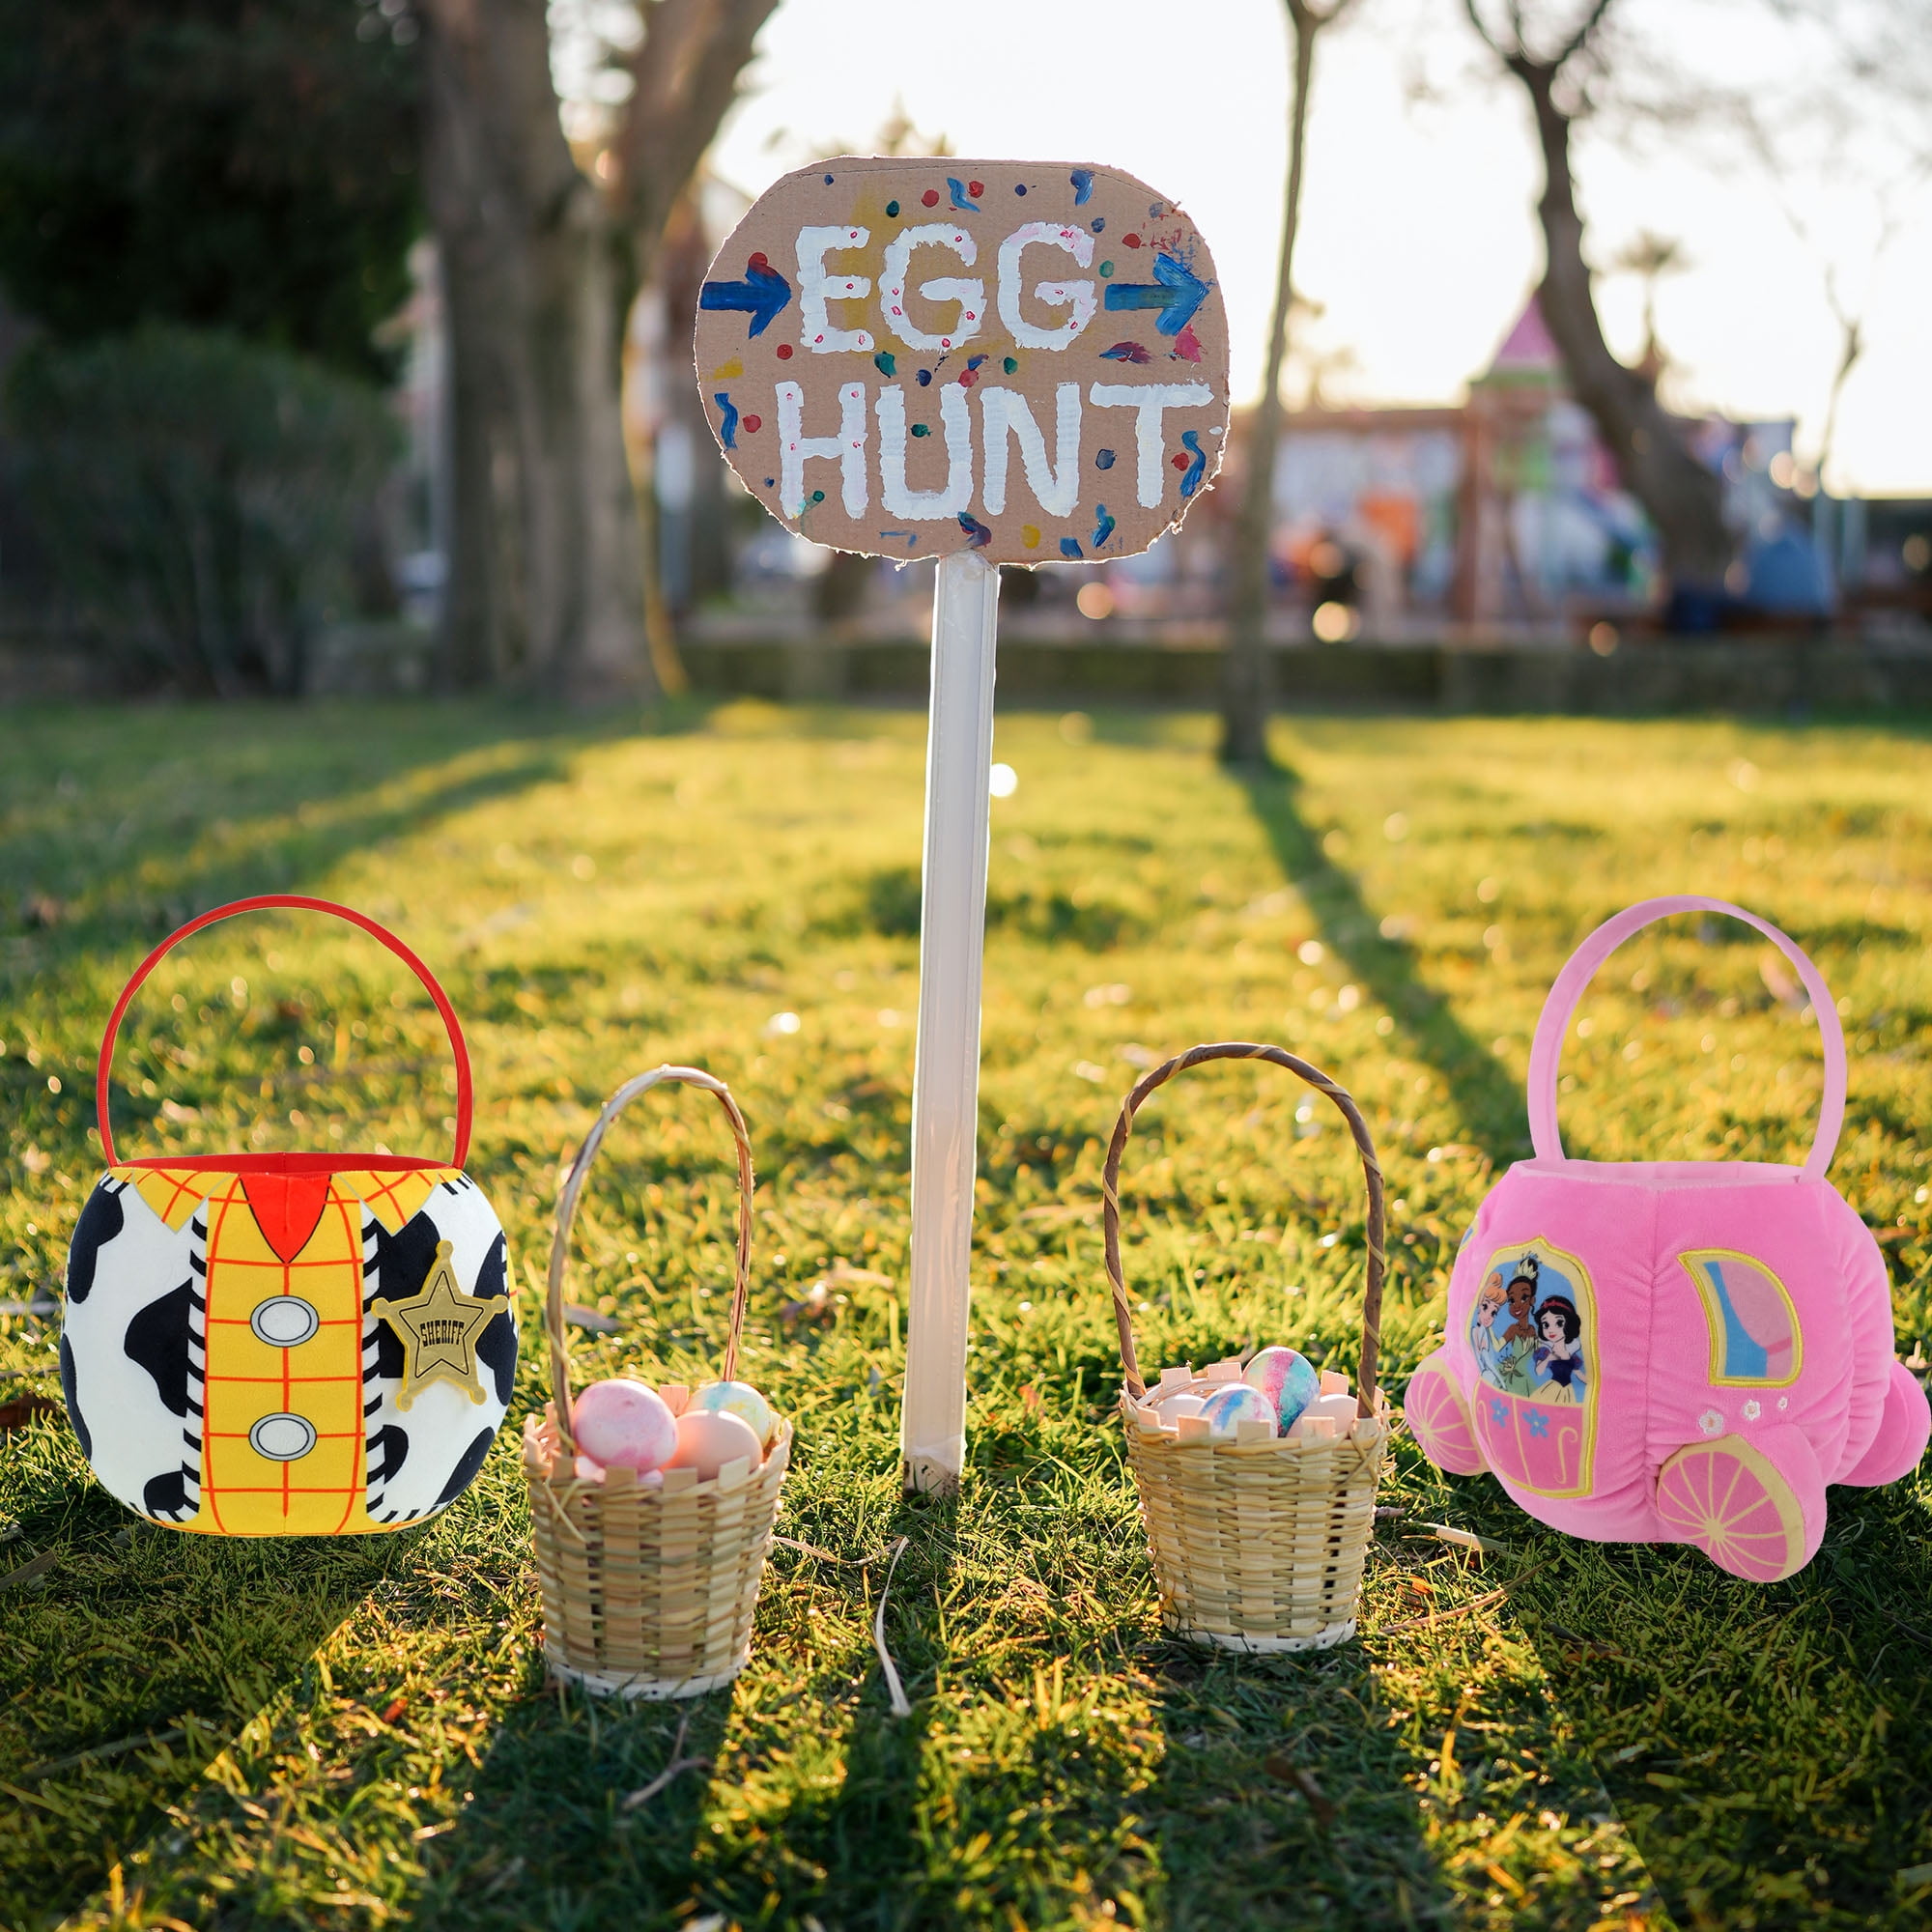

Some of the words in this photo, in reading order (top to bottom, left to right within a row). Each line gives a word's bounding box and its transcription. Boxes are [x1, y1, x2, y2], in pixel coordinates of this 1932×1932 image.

[795, 221, 1097, 354] EGG
[775, 382, 1214, 520] HUNT
[420, 1320, 464, 1347] SHERIFF
